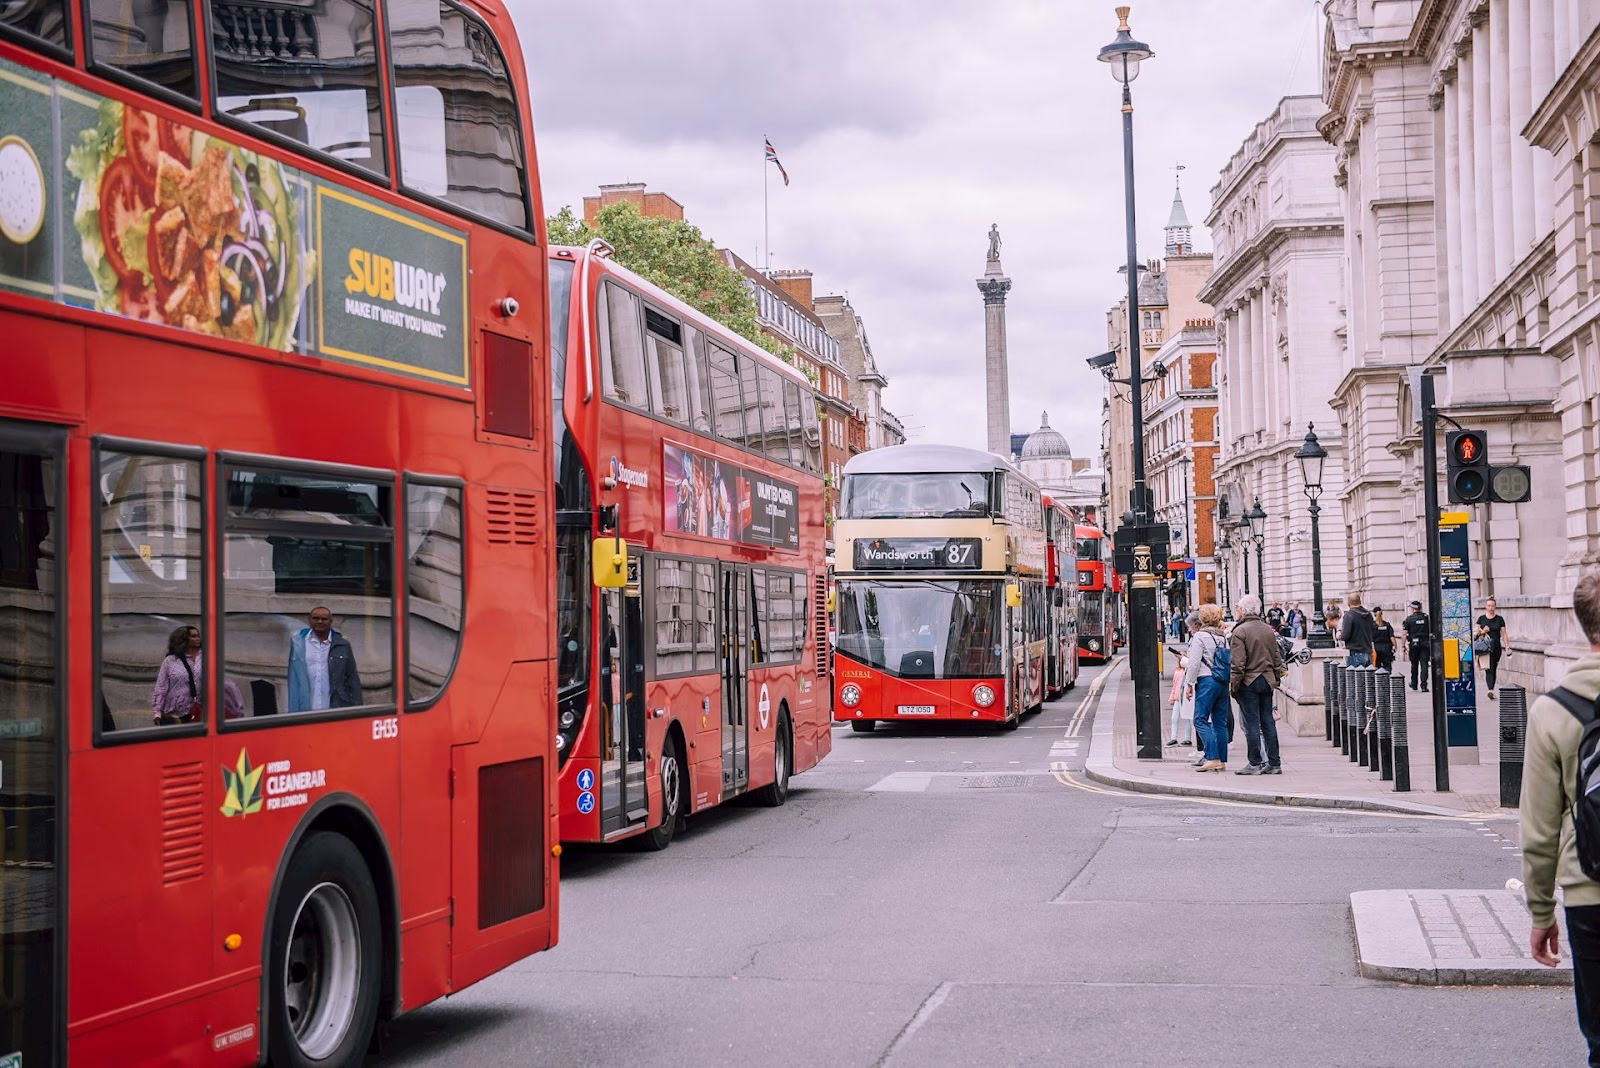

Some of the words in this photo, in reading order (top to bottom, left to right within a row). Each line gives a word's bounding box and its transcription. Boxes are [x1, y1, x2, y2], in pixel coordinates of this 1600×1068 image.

[344, 248, 447, 316] SUBWAY
[345, 298, 371, 318] MAKE
[371, 304, 380, 321] IT
[380, 307, 405, 328] WHAT
[404, 313, 421, 332] YOU
[618, 461, 648, 489] Stagecoach
[863, 549, 934, 560] Wandsworth
[948, 544, 973, 564] 87
[842, 670, 872, 678] GENERAL
[267, 760, 290, 774] HYBRID
[266, 798, 281, 810] FOR
[281, 793, 308, 808] LONDON
